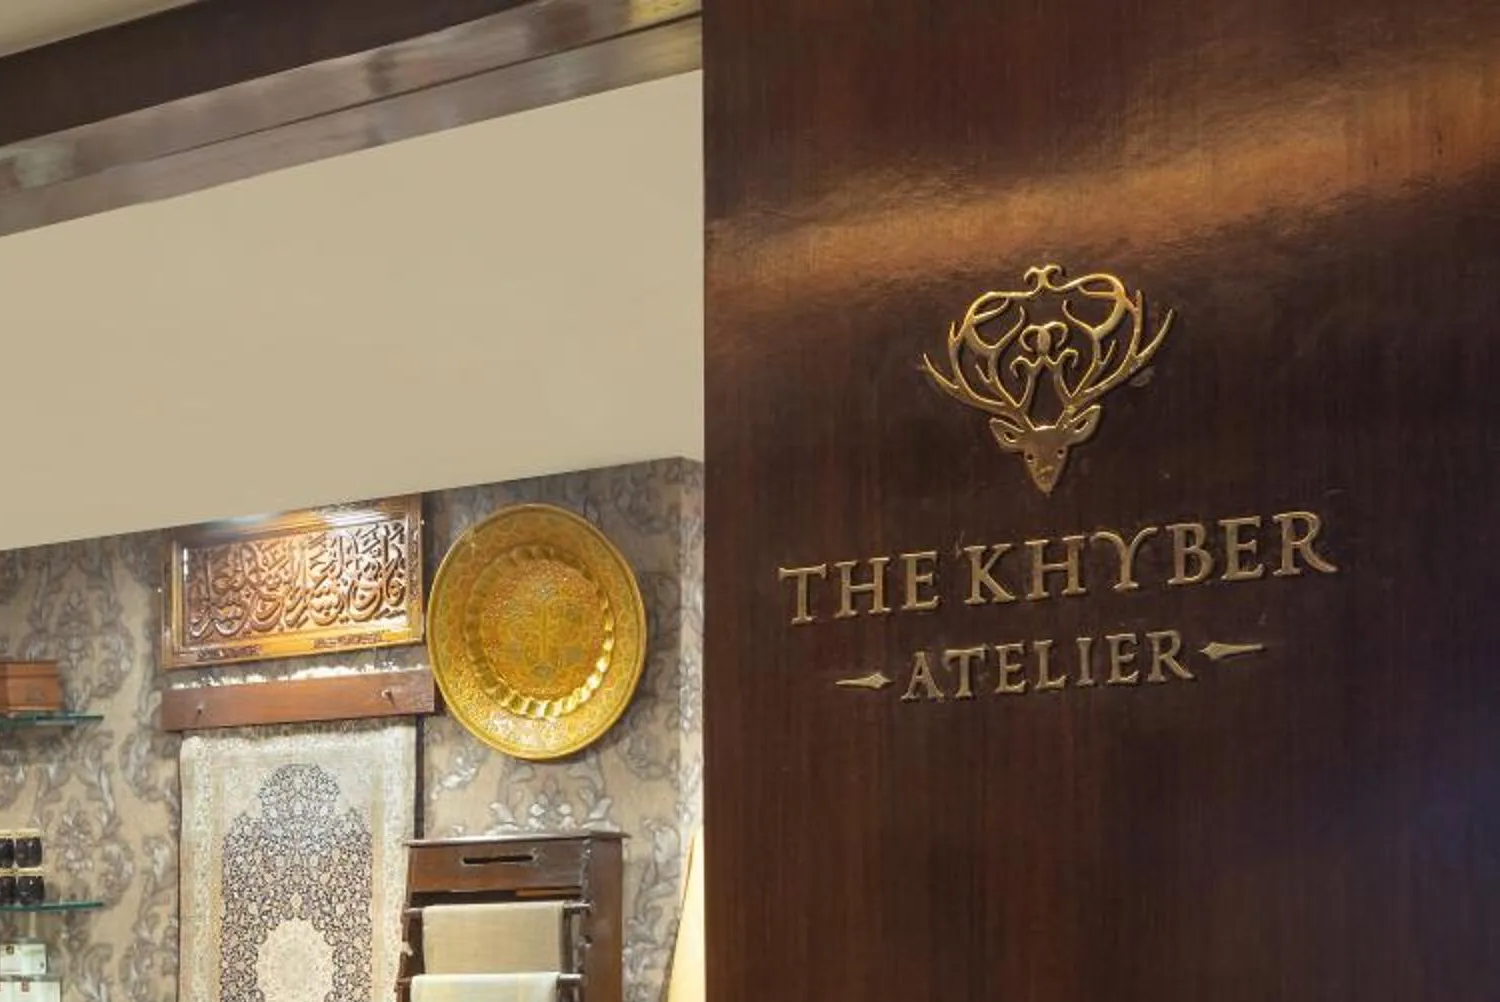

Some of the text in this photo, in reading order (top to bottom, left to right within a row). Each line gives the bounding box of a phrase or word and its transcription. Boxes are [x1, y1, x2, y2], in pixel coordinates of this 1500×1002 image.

[779, 510, 1338, 626] THE KHYBER
[901, 629, 1196, 702] ATELIER
